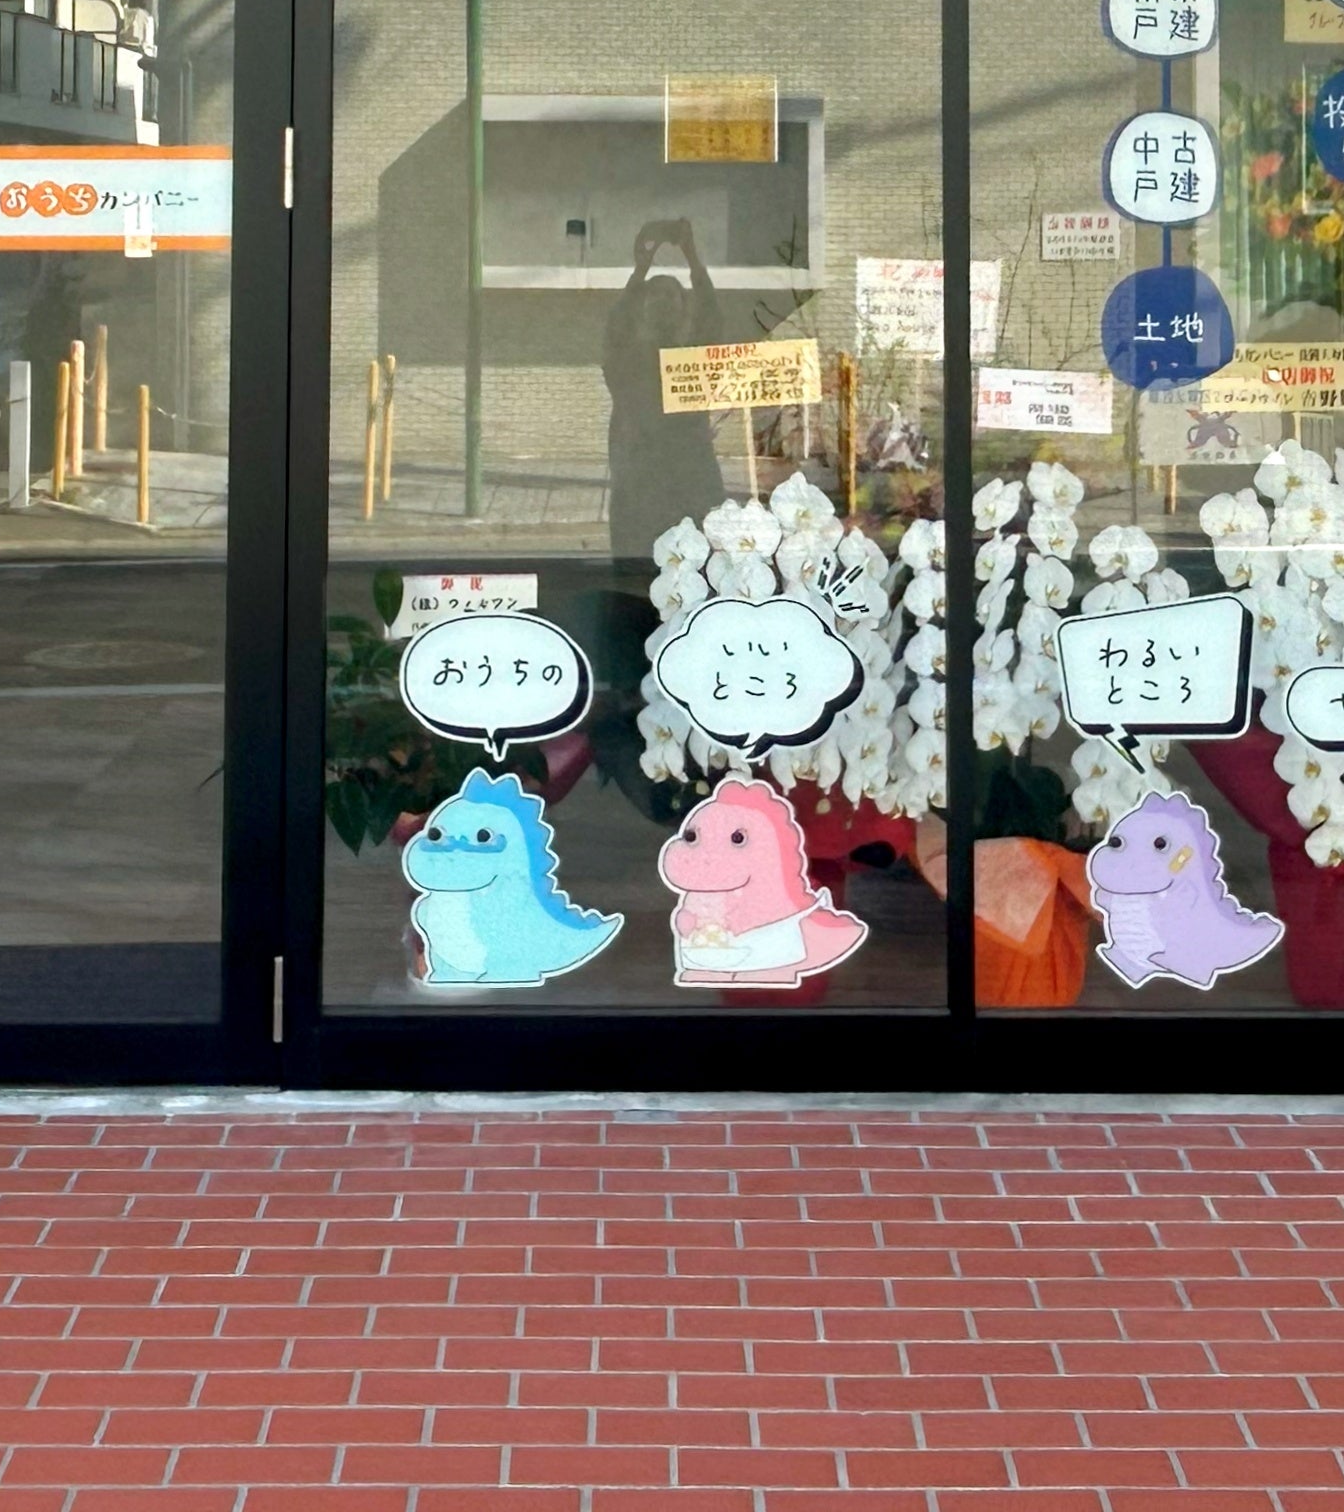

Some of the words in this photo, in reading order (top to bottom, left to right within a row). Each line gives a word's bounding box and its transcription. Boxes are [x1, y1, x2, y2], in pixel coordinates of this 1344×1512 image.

[1133, 6, 1200, 41] 戸建
[1132, 130, 1198, 165] 中古
[1133, 170, 1201, 204] 戸建
[1133, 311, 1204, 343] 土地
[722, 641, 789, 658] いい
[1098, 637, 1202, 669] わるい
[432, 657, 563, 687] おうちの
[712, 672, 799, 700] ところ
[1106, 675, 1194, 705] ところ
